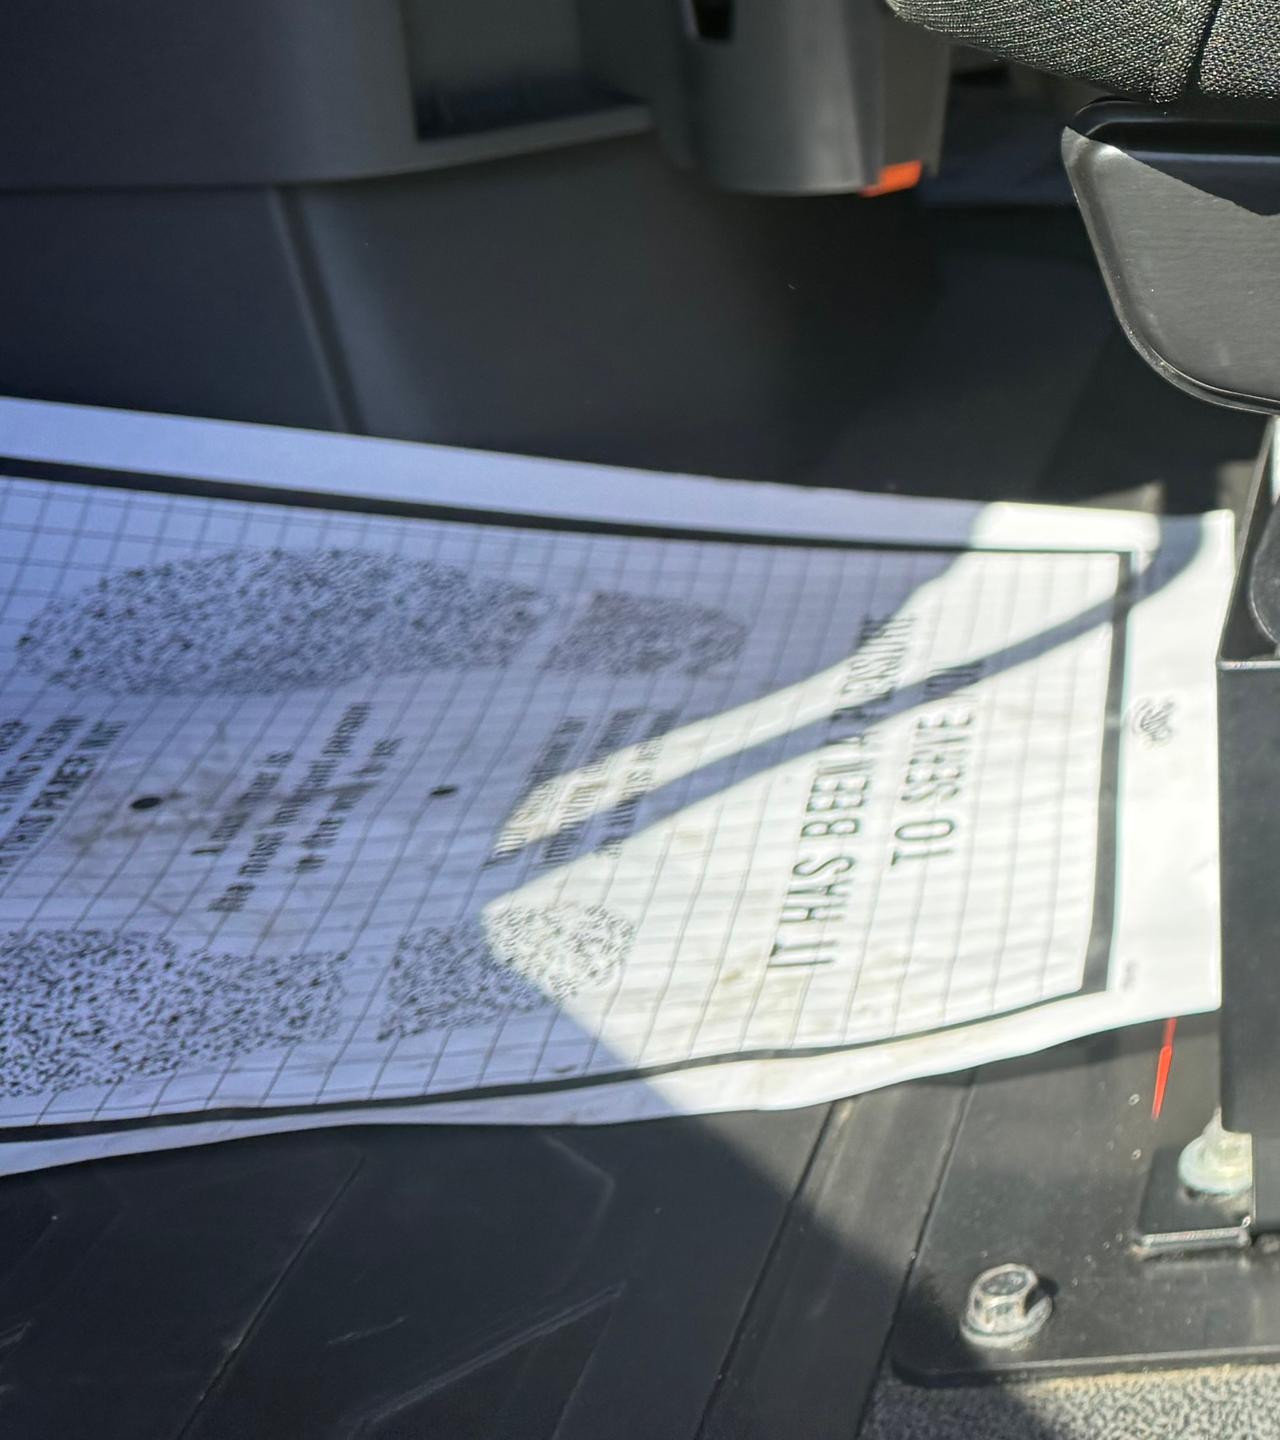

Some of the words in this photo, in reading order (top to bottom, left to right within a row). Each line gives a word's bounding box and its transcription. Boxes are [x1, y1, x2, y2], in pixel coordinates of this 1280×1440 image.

[900, 710, 975, 802] SERVE
[799, 758, 876, 838] BEEN
[889, 818, 956, 867] TO
[778, 855, 856, 924] HAS
[766, 938, 838, 969] IT
